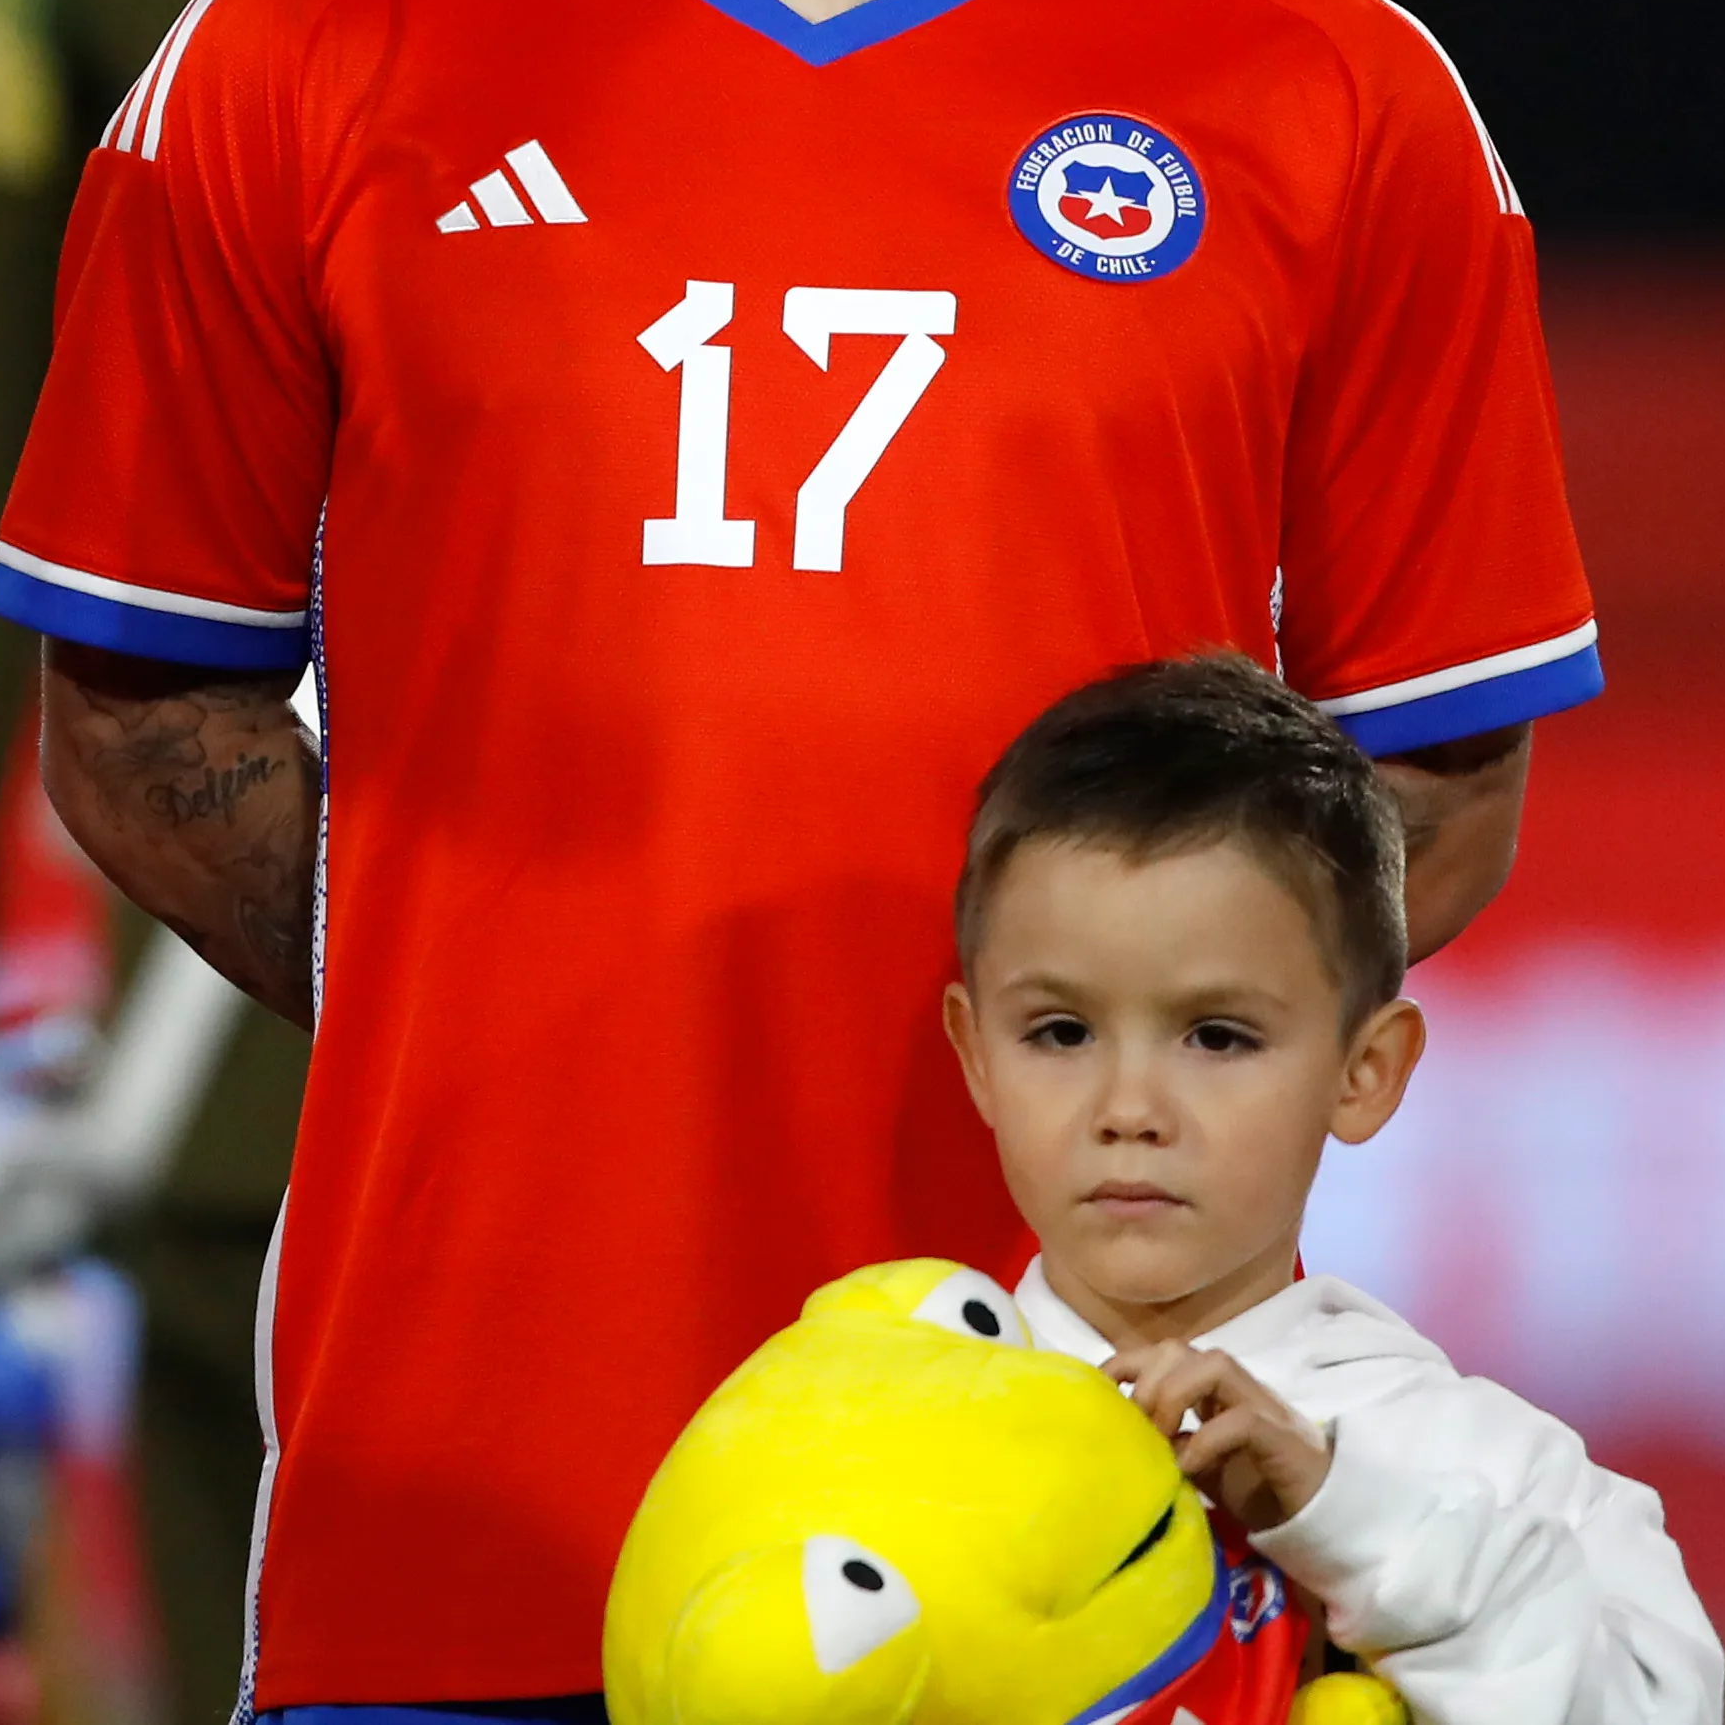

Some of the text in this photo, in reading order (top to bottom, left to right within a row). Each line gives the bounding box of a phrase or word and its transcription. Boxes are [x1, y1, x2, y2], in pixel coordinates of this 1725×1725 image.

[1016, 123, 1197, 218] FEDERACION DE FUTBOL
[1056, 242, 1152, 275] DE CHILE
[636, 279, 958, 573] 17
